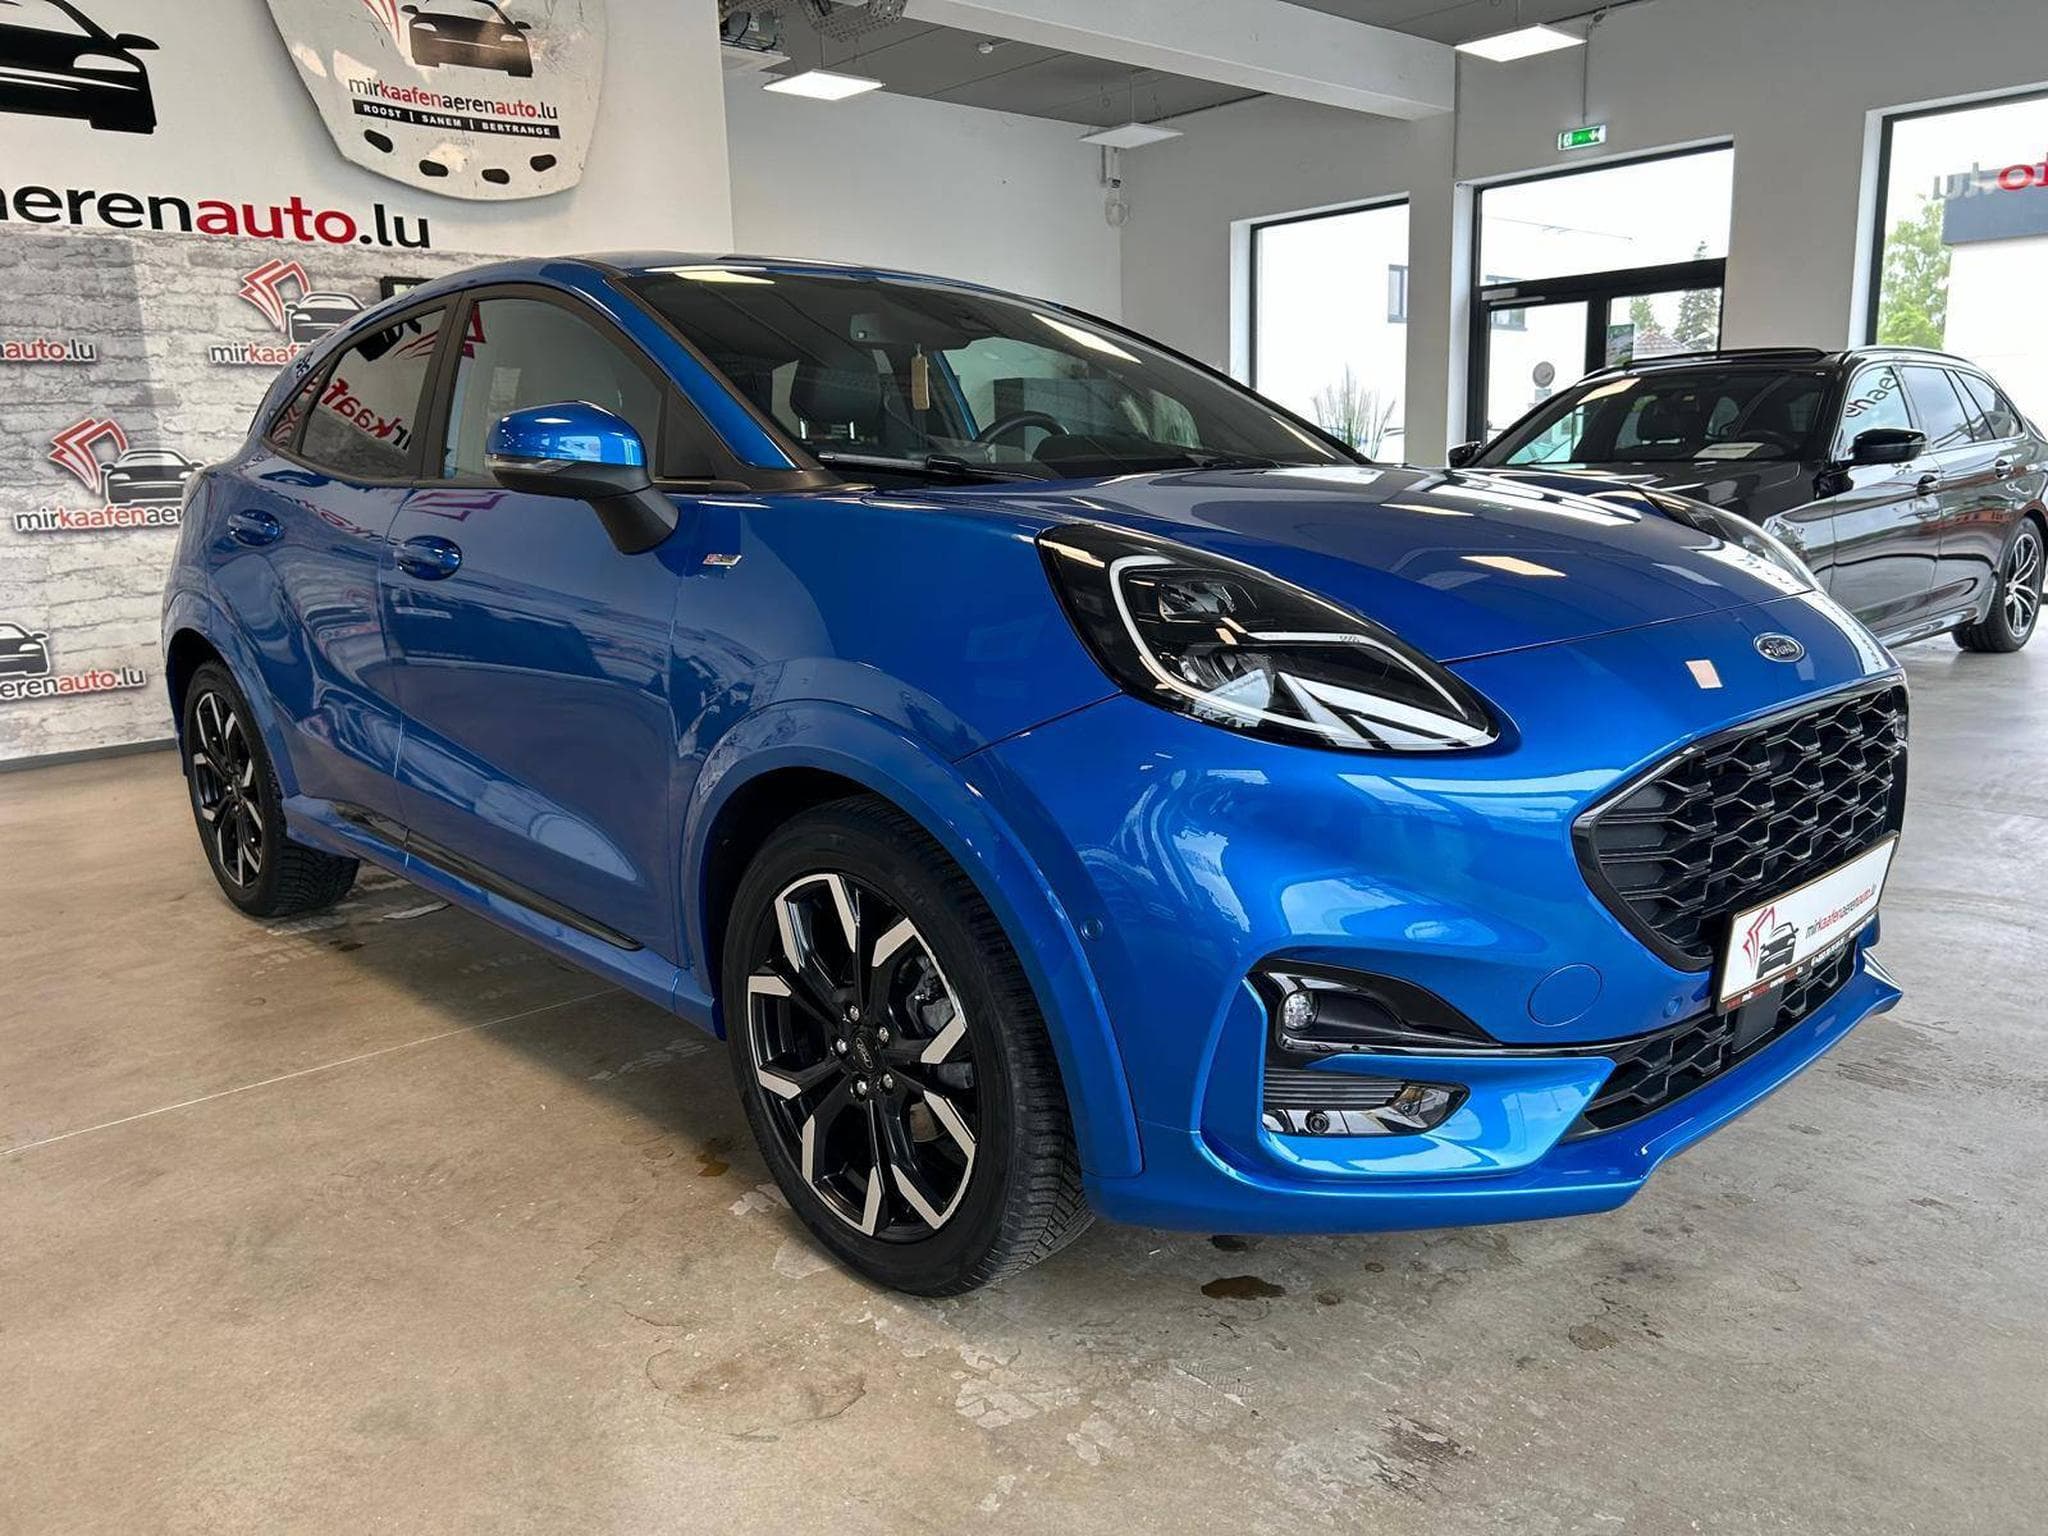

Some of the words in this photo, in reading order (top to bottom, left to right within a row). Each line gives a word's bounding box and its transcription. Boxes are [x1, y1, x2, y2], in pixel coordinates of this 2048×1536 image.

[349, 79, 558, 119] mirkaafenaerenauto.lu
[363, 104, 402, 118] ROOST
[422, 115, 462, 127] SANEM
[482, 122, 551, 136] BERTRANGE
